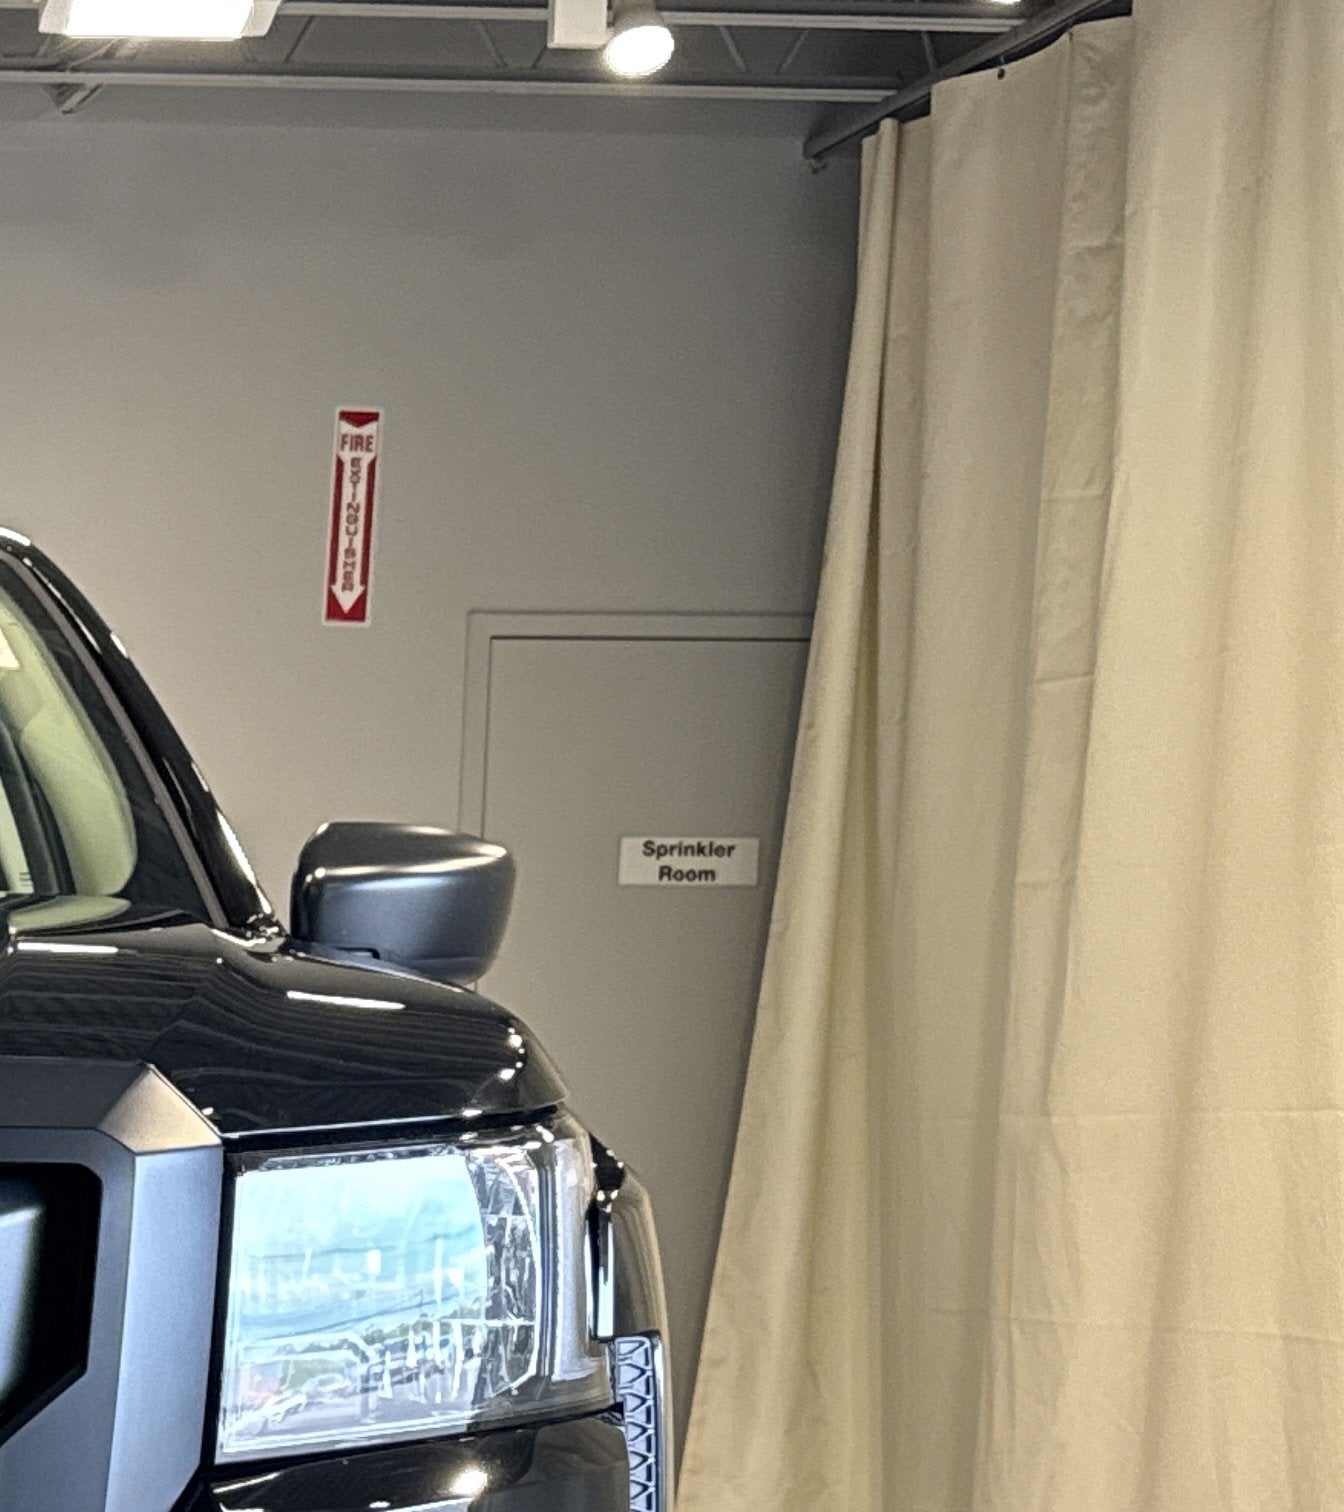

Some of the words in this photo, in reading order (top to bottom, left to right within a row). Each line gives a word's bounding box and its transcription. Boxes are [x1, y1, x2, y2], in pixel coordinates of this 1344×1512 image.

[340, 434, 374, 453] FIRE
[341, 457, 362, 592] EXTINGUISHER
[642, 840, 736, 860] Sprinkler
[658, 865, 716, 881] Room
